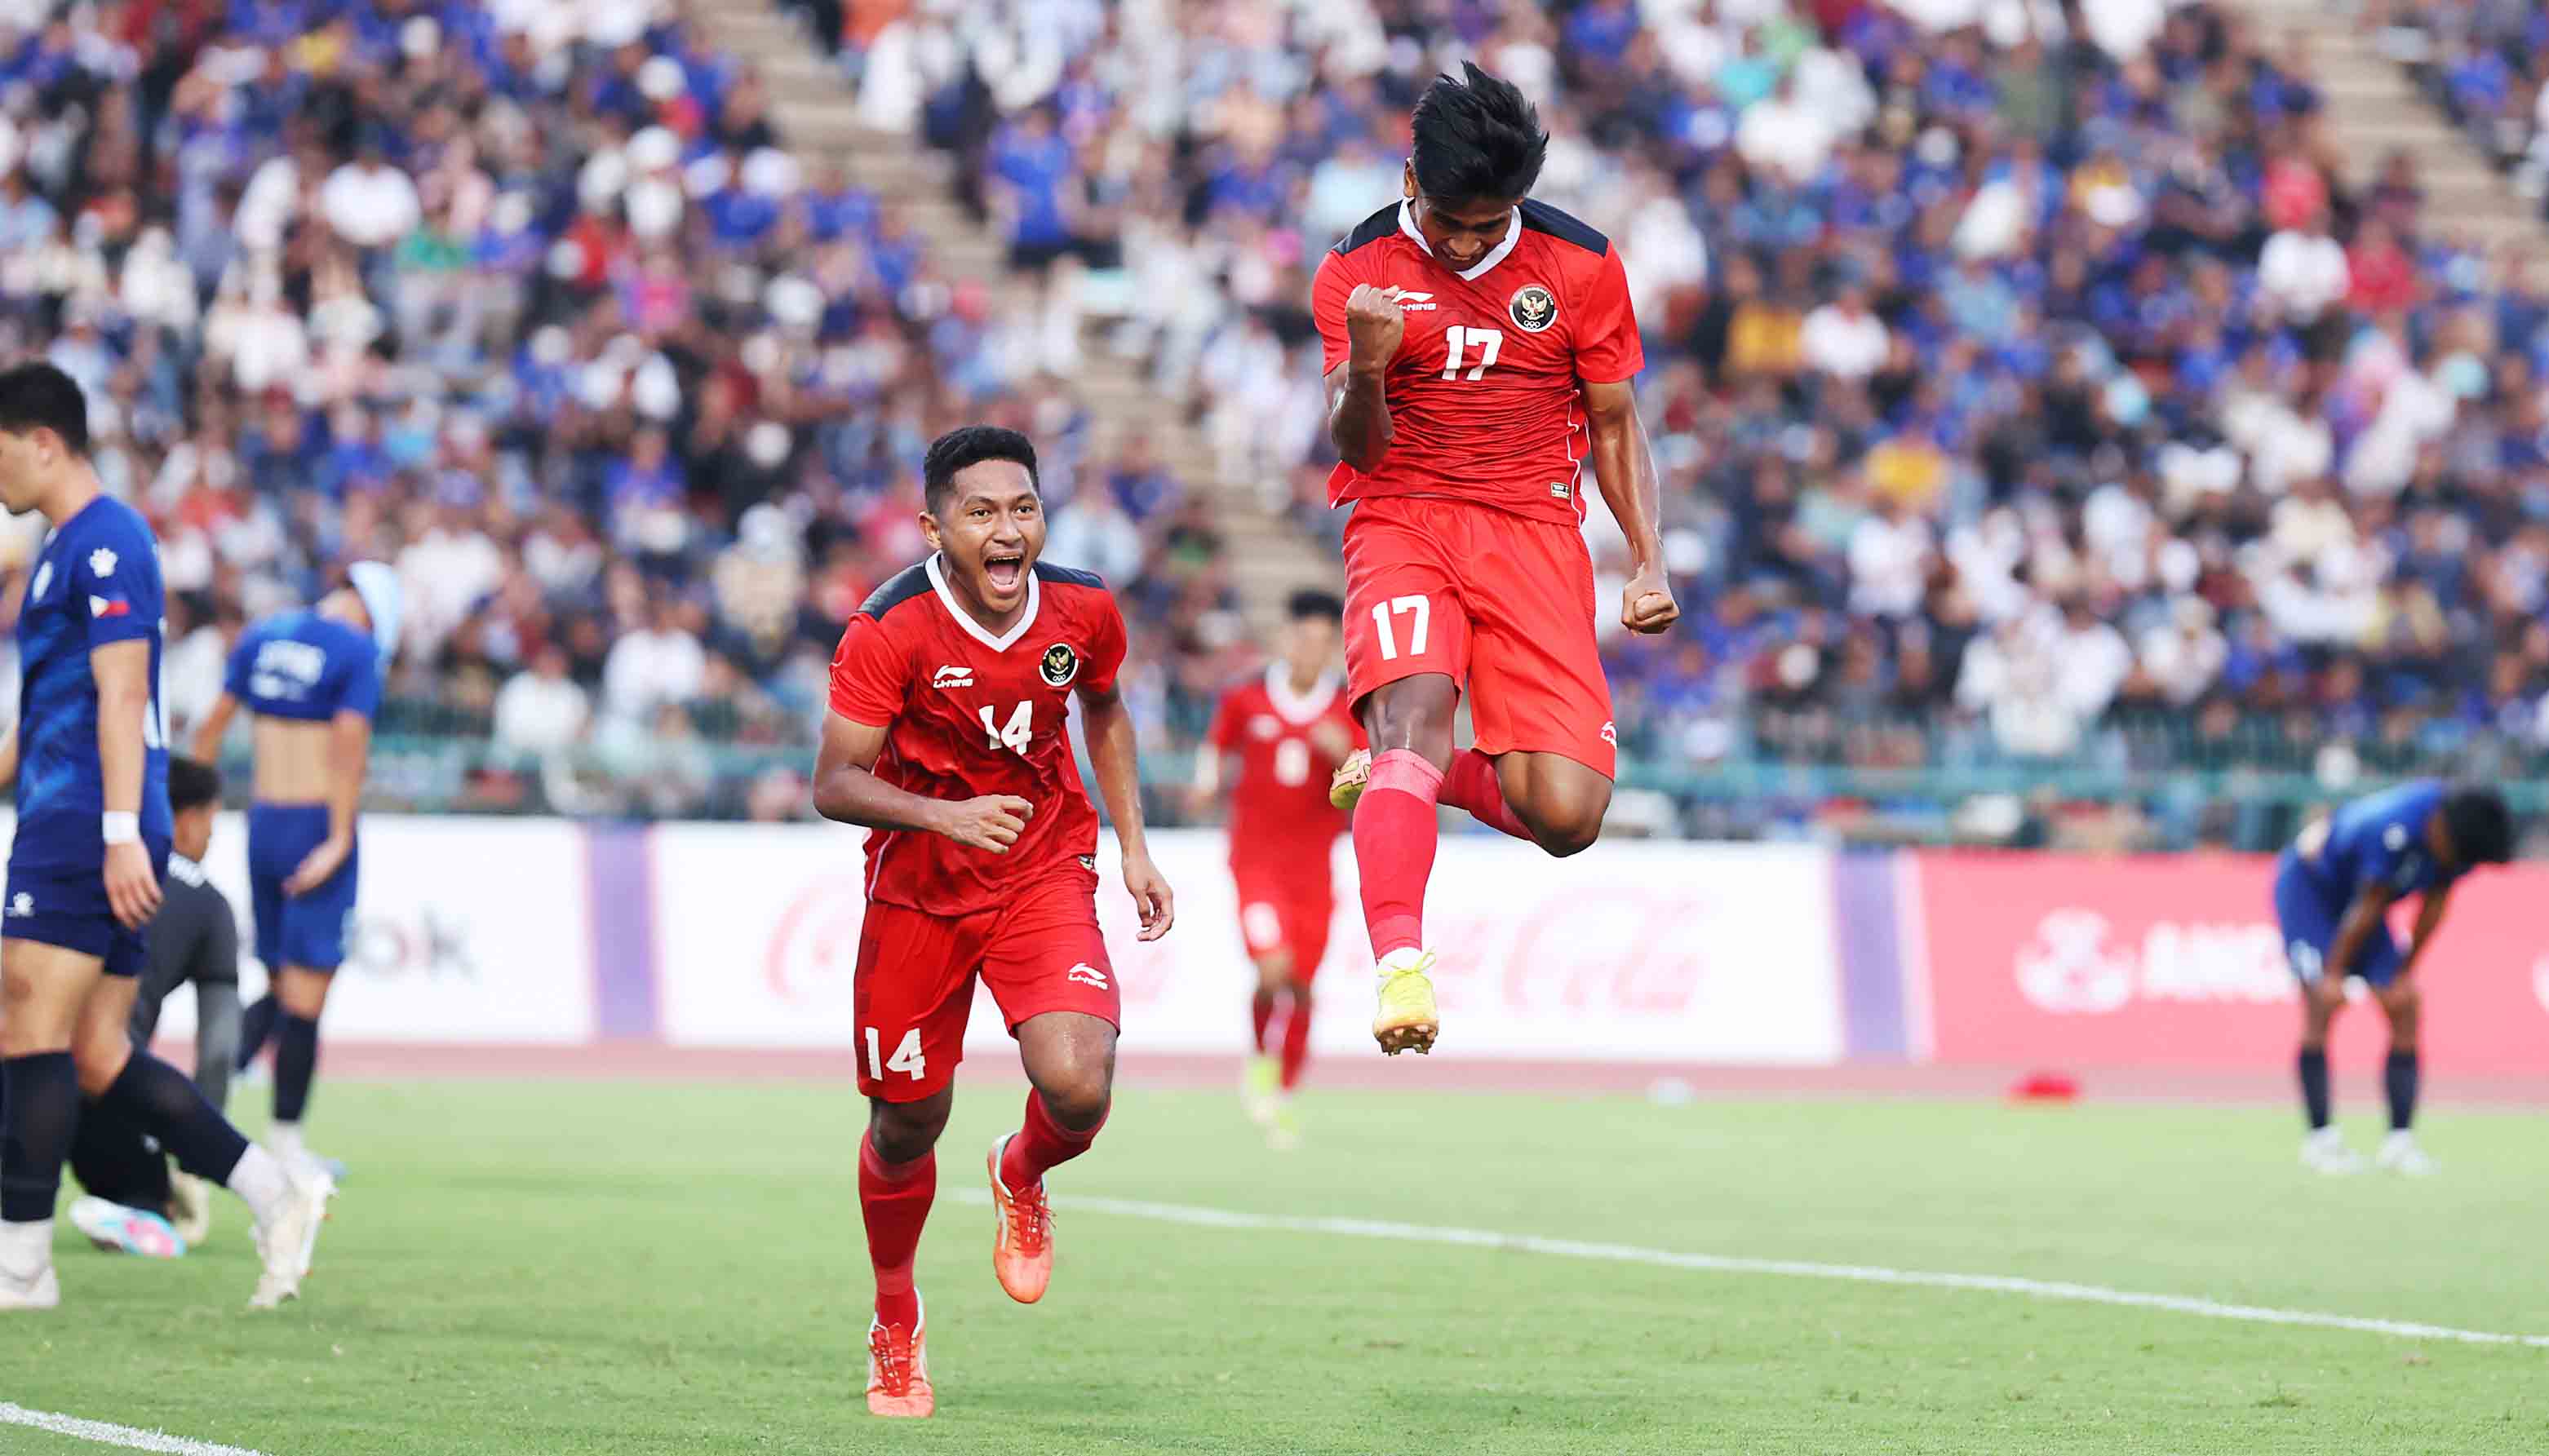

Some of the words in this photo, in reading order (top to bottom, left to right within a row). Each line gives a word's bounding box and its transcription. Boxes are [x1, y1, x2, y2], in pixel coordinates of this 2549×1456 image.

[1442, 325, 1504, 381] 17
[1372, 594, 1430, 661] 17
[978, 700, 1033, 756] 14
[865, 1026, 926, 1082] 14
